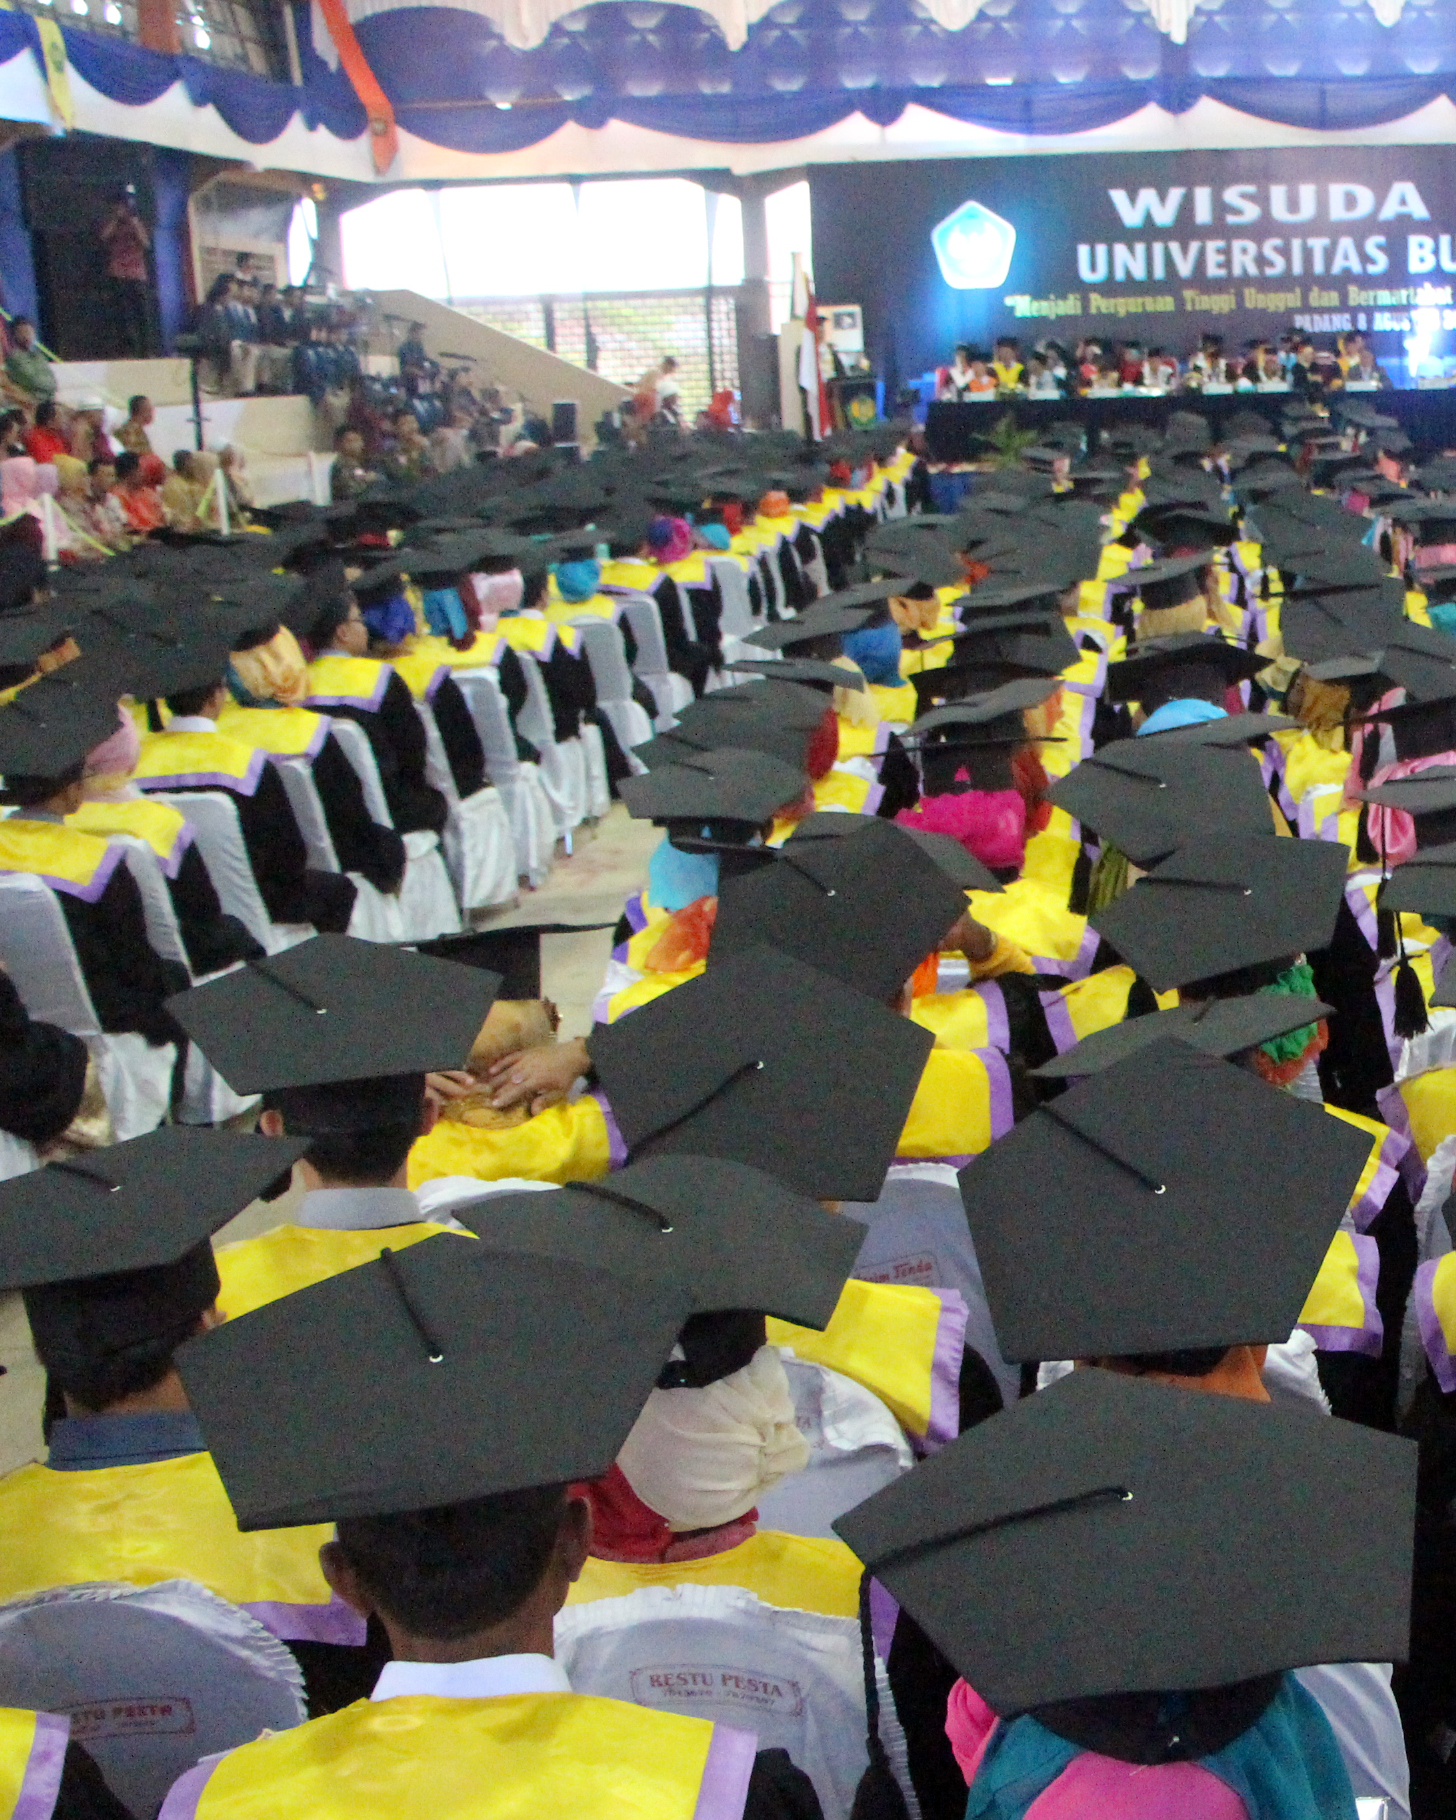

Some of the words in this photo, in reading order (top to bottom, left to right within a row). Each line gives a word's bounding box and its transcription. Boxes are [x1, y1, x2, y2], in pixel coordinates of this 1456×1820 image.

[1109, 182, 1431, 228] WISUDA
[1077, 236, 1389, 283] UNIVERSITAS
[1308, 286, 1340, 307] dan
[650, 1672, 714, 1687] RESTU
[721, 1673, 783, 1698] PESTA
